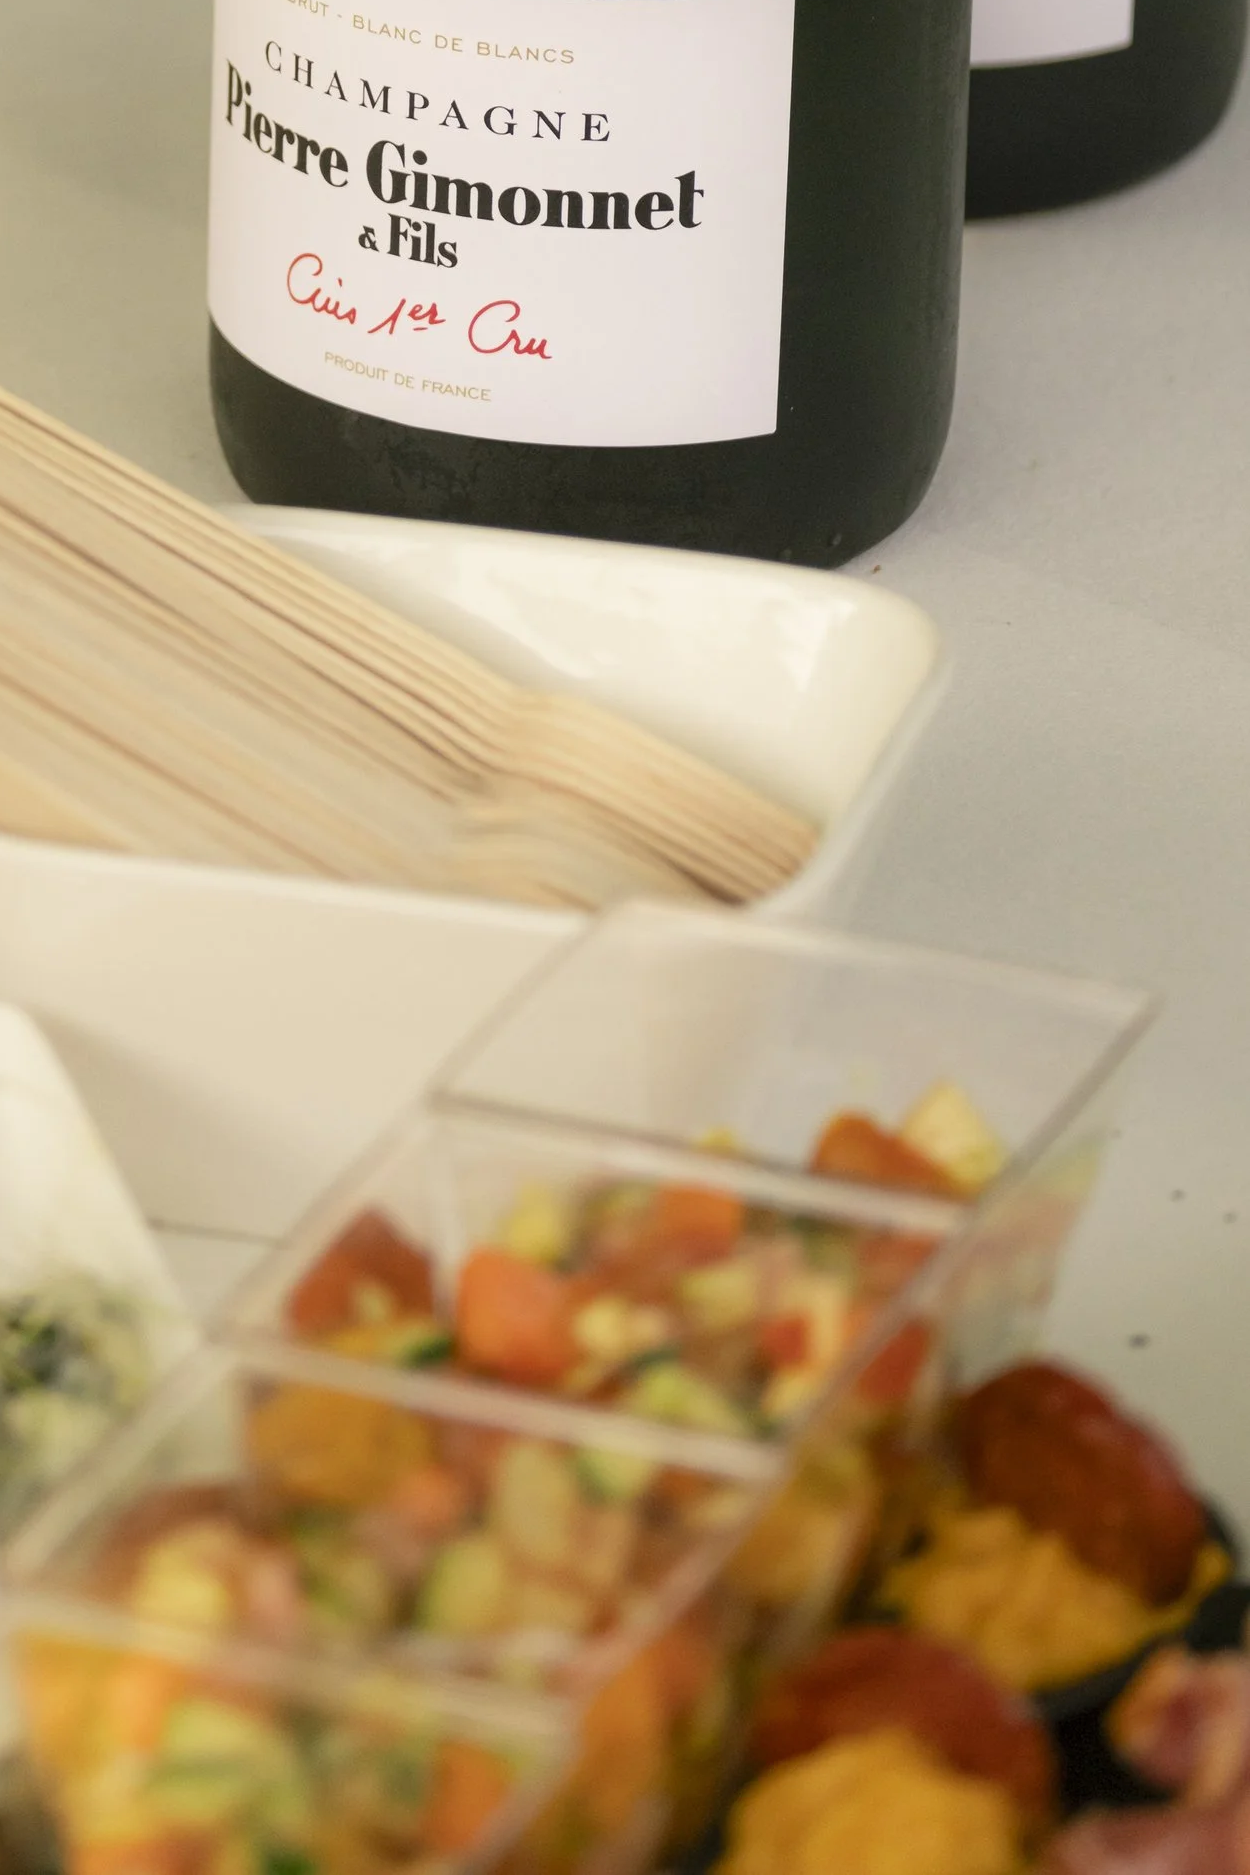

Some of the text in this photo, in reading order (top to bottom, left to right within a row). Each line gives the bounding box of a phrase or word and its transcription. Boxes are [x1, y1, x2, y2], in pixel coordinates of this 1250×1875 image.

[352, 14, 422, 44] BLANC
[434, 34, 463, 53] DE
[477, 41, 575, 64] BLANCS
[264, 39, 611, 143] CHAMPAGNE
[225, 59, 705, 231] Pierre Gimonnet
[358, 213, 458, 268] & Fils
[287, 253, 552, 360] Cuis 1er Cru
[324, 351, 491, 402] PRODUIT DE FRANCE
